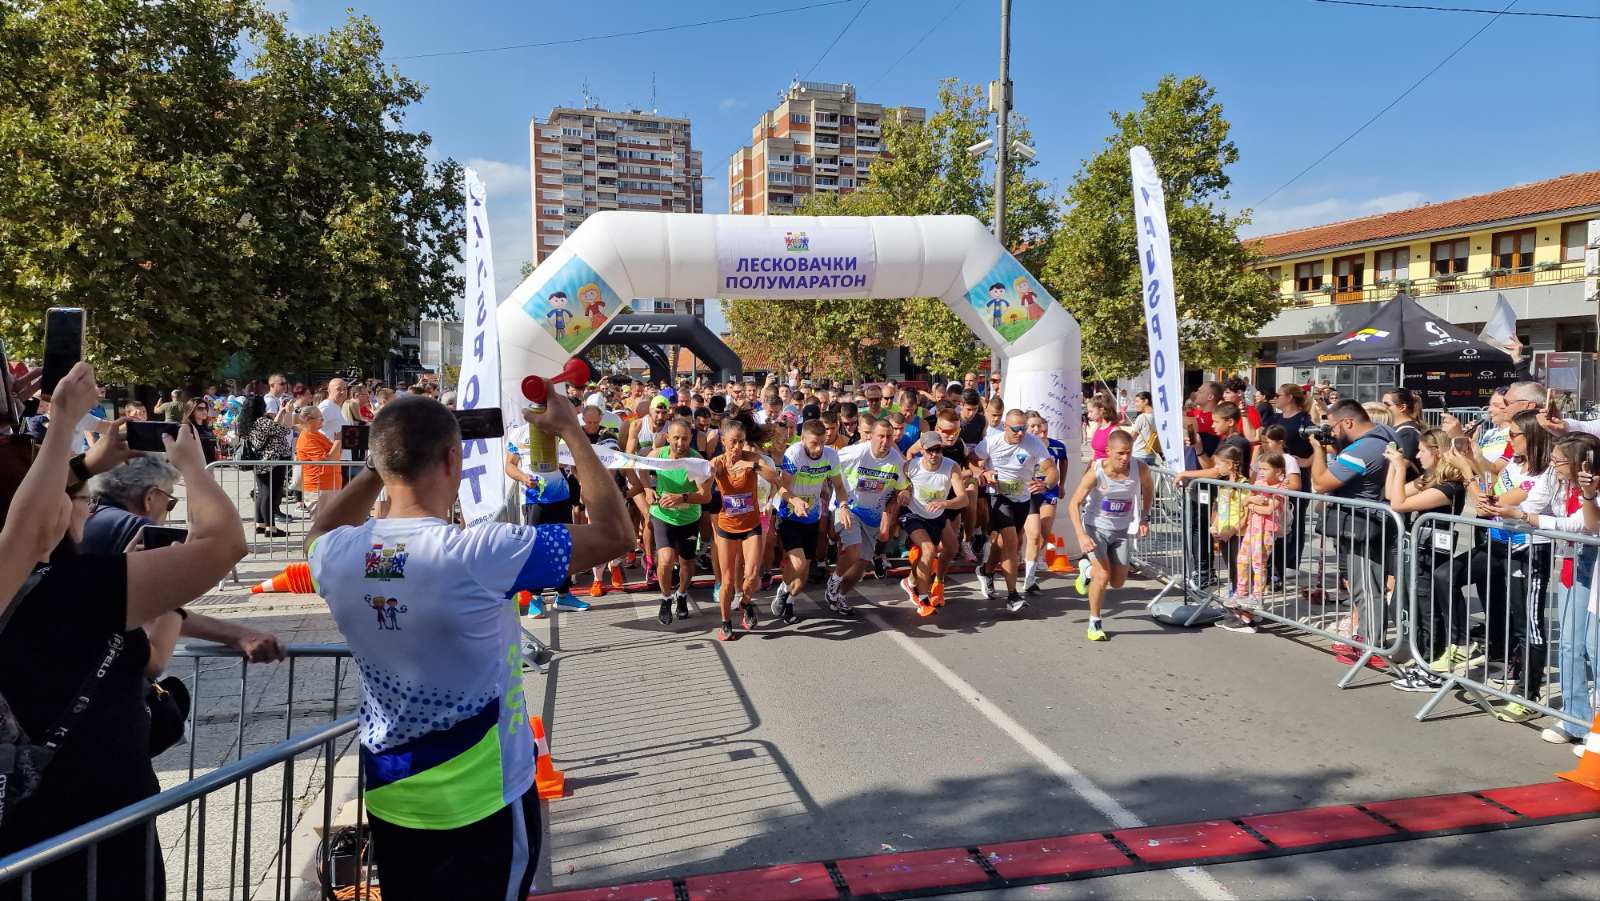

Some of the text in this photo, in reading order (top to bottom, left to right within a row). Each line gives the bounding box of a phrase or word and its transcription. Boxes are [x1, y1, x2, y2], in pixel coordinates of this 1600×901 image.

[736, 257, 857, 272] ЛЕСКОВАЧКИ
[726, 274, 866, 289] ПОЛУМАРАТОН
[608, 323, 678, 335] polar
